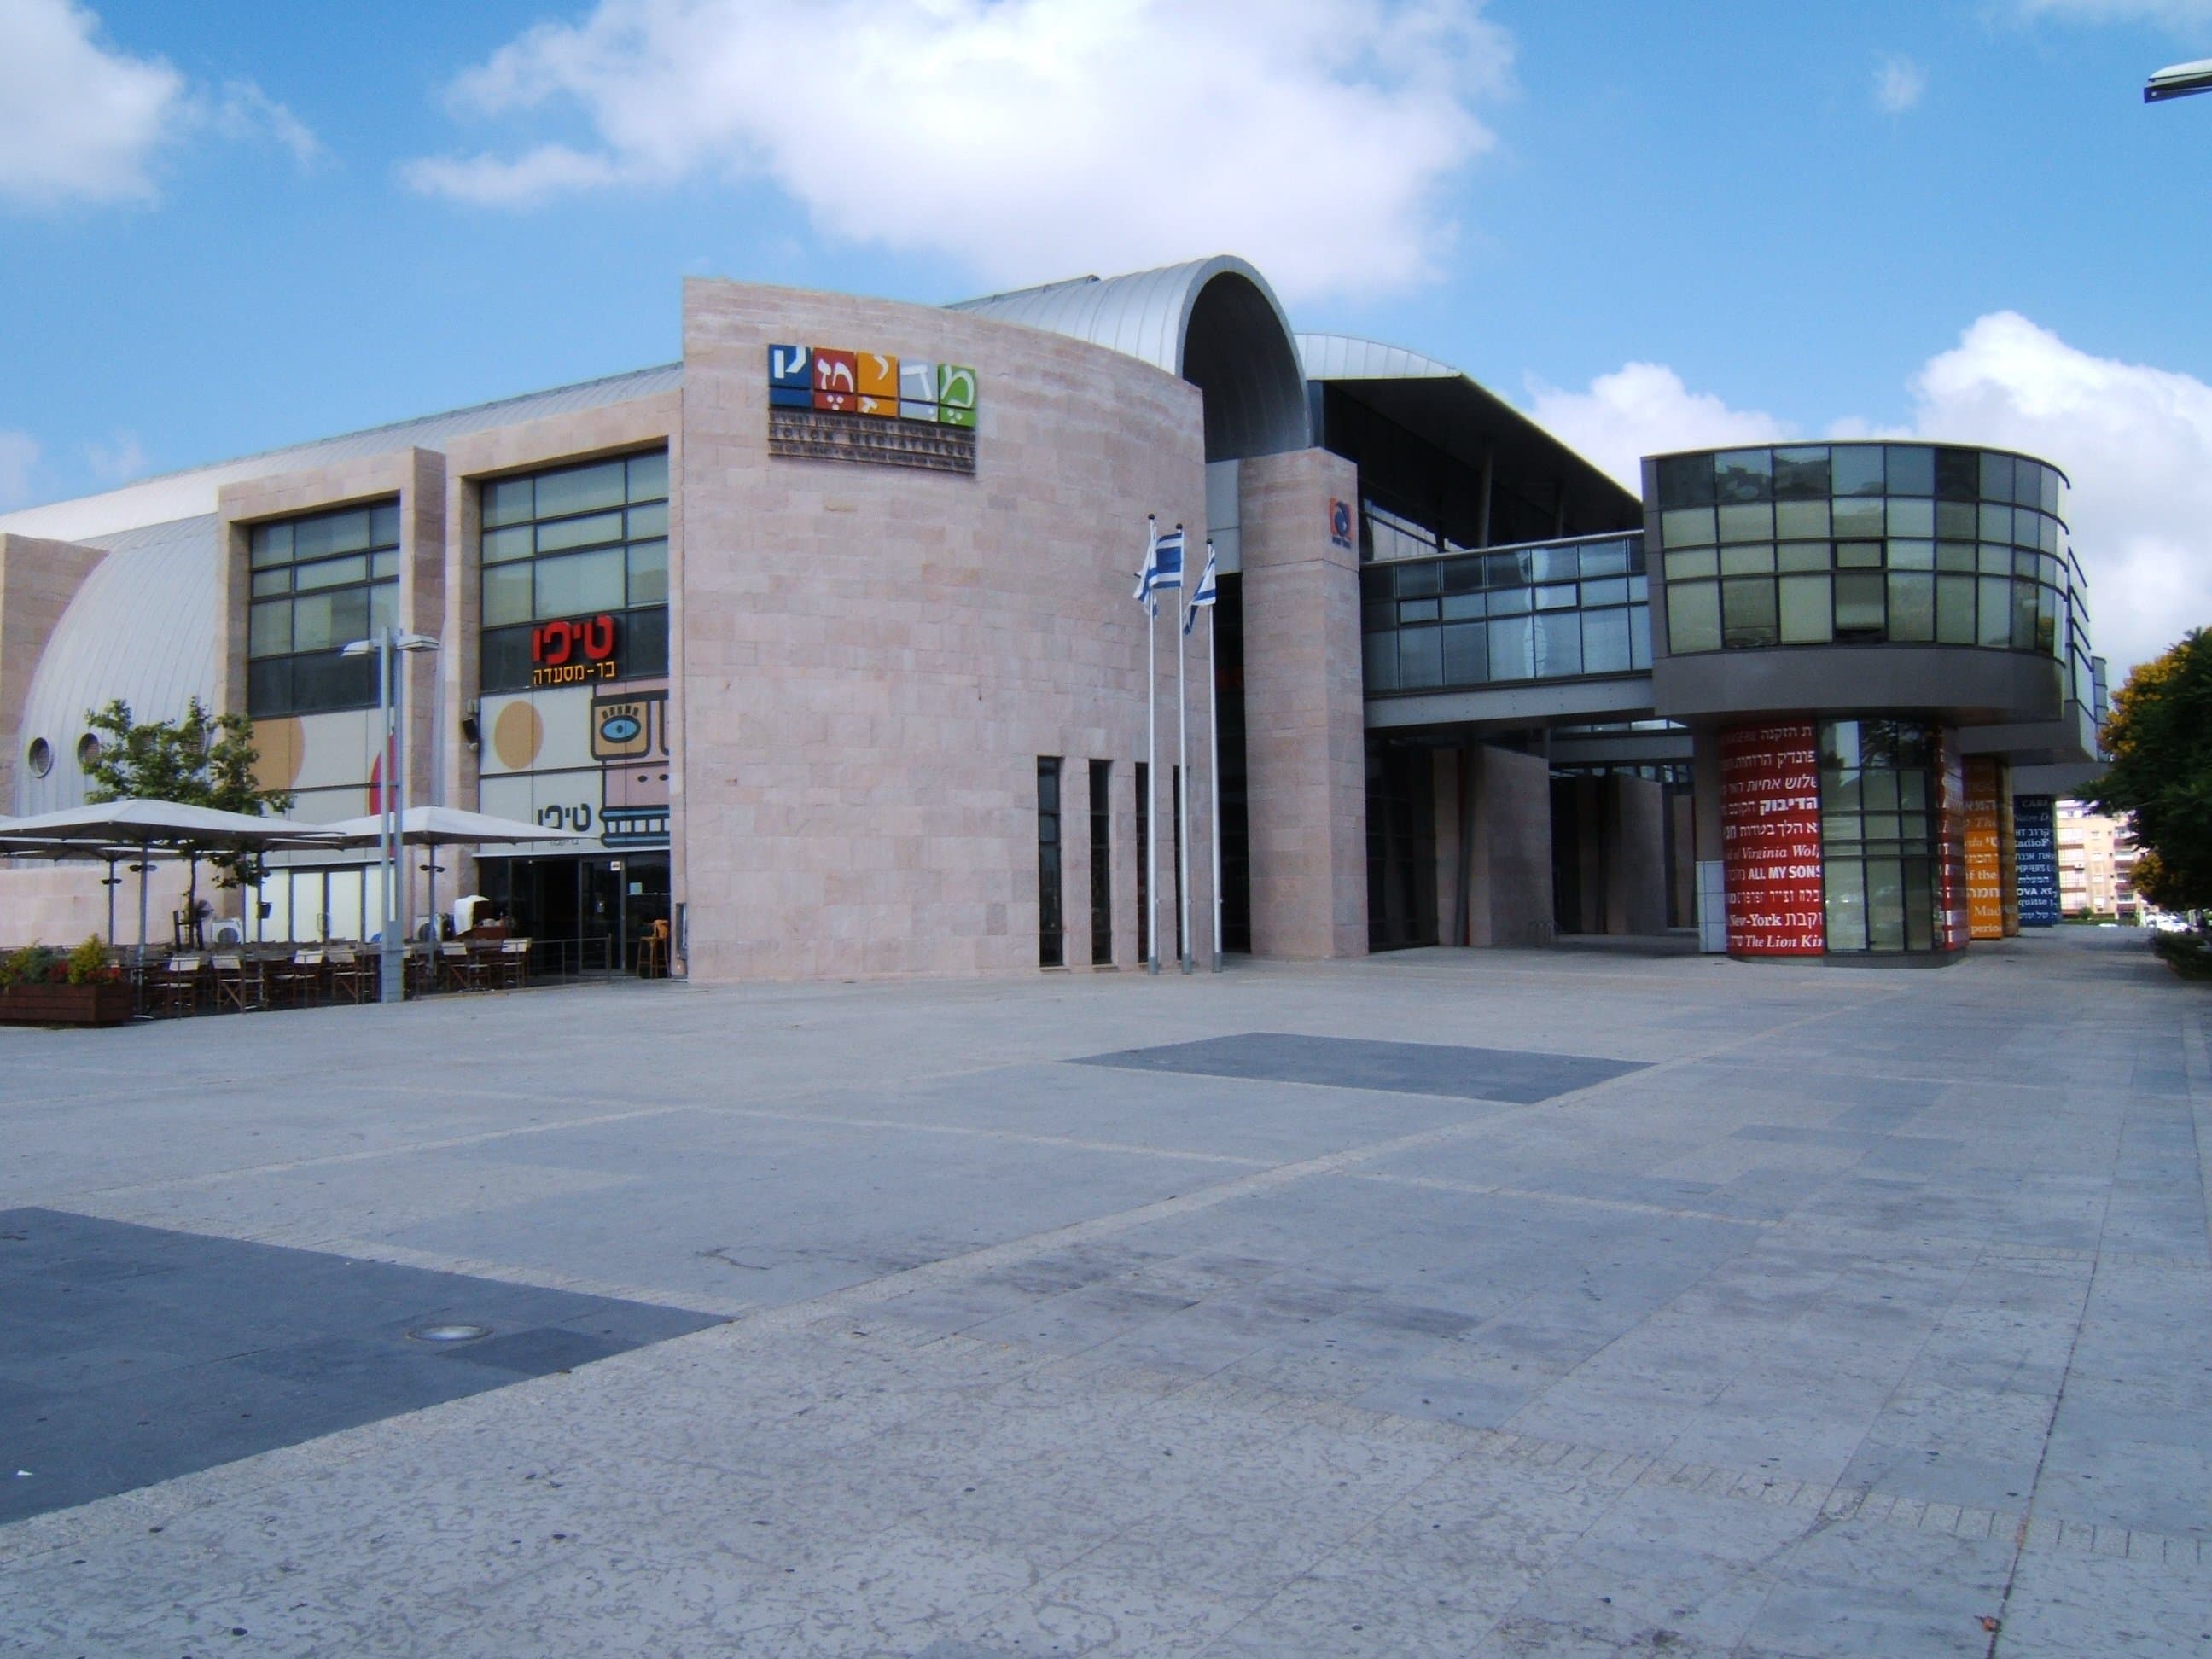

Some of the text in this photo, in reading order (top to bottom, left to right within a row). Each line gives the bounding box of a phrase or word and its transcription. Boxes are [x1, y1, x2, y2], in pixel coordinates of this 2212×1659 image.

[533, 614, 614, 665] טיפו
[1759, 797, 1818, 816] הדיבוק
[1743, 847, 1788, 860] Virginia
[1748, 867, 1766, 881] ALL
[1768, 866, 1787, 880] MY
[2016, 888, 2039, 896] OVA
[1745, 934, 1765, 948] The
[1767, 934, 1796, 948] Lion
